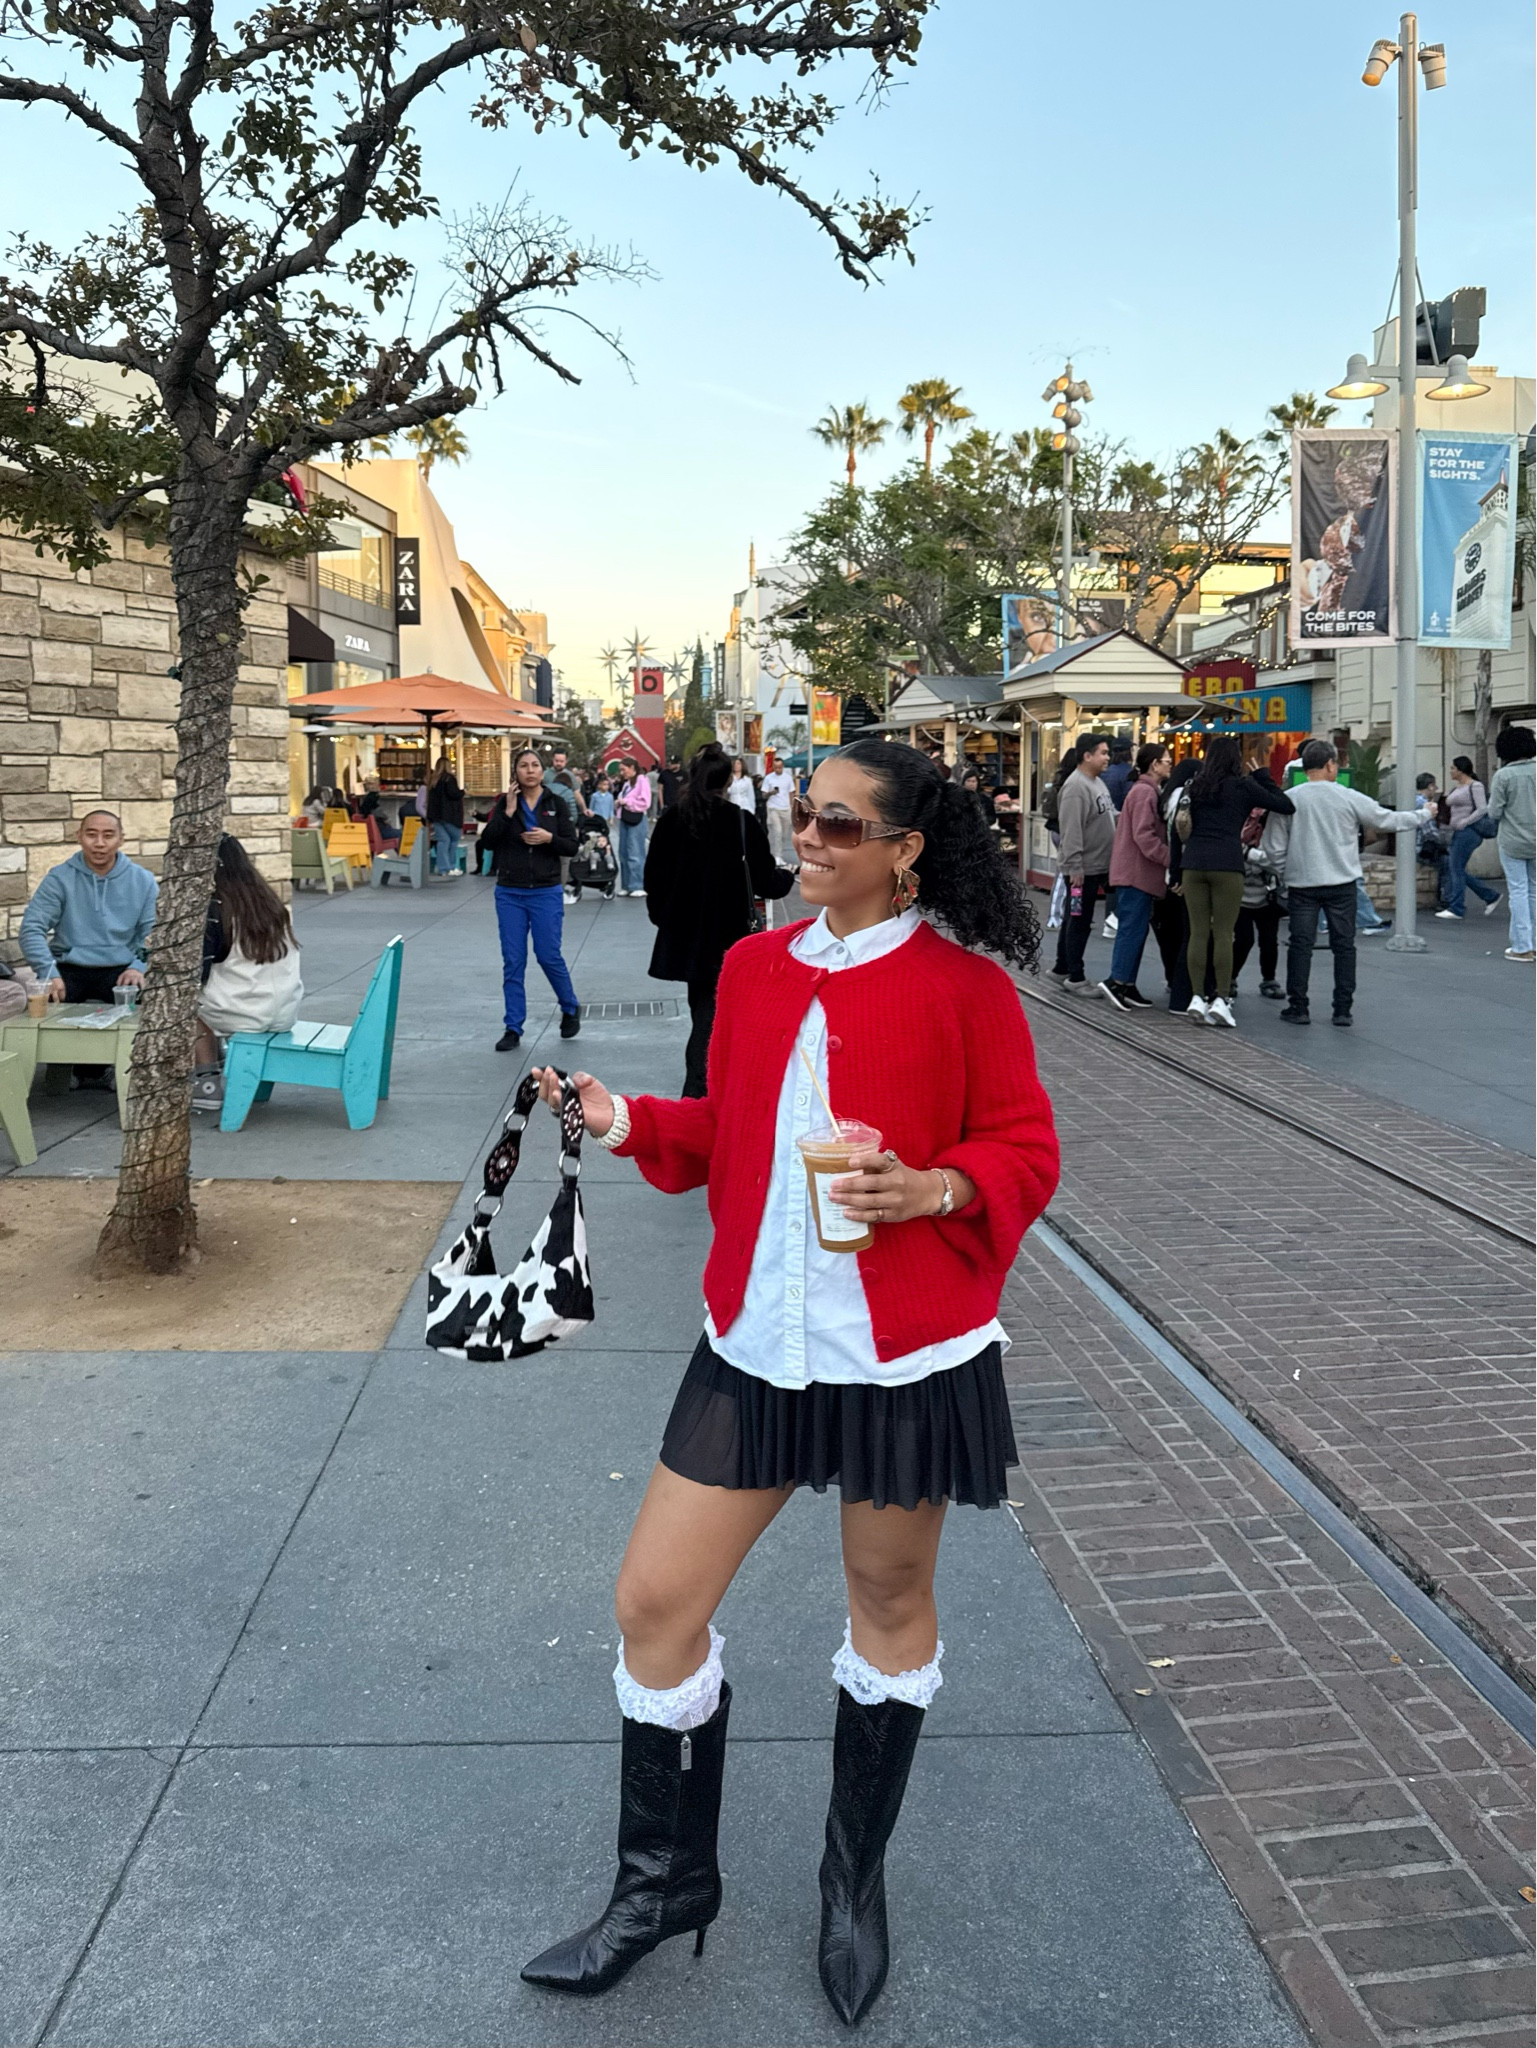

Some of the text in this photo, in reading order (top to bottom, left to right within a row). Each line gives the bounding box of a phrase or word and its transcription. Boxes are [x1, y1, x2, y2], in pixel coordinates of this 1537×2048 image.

[1429, 447, 1463, 457] STAY
[1429, 458, 1486, 470] FOR THE
[1429, 469, 1481, 480] SIGHTS.
[397, 551, 416, 611] ZARA
[1305, 610, 1376, 621] COME FOR
[1305, 621, 1375, 632] THE BITES
[1182, 676, 1244, 697] ERO
